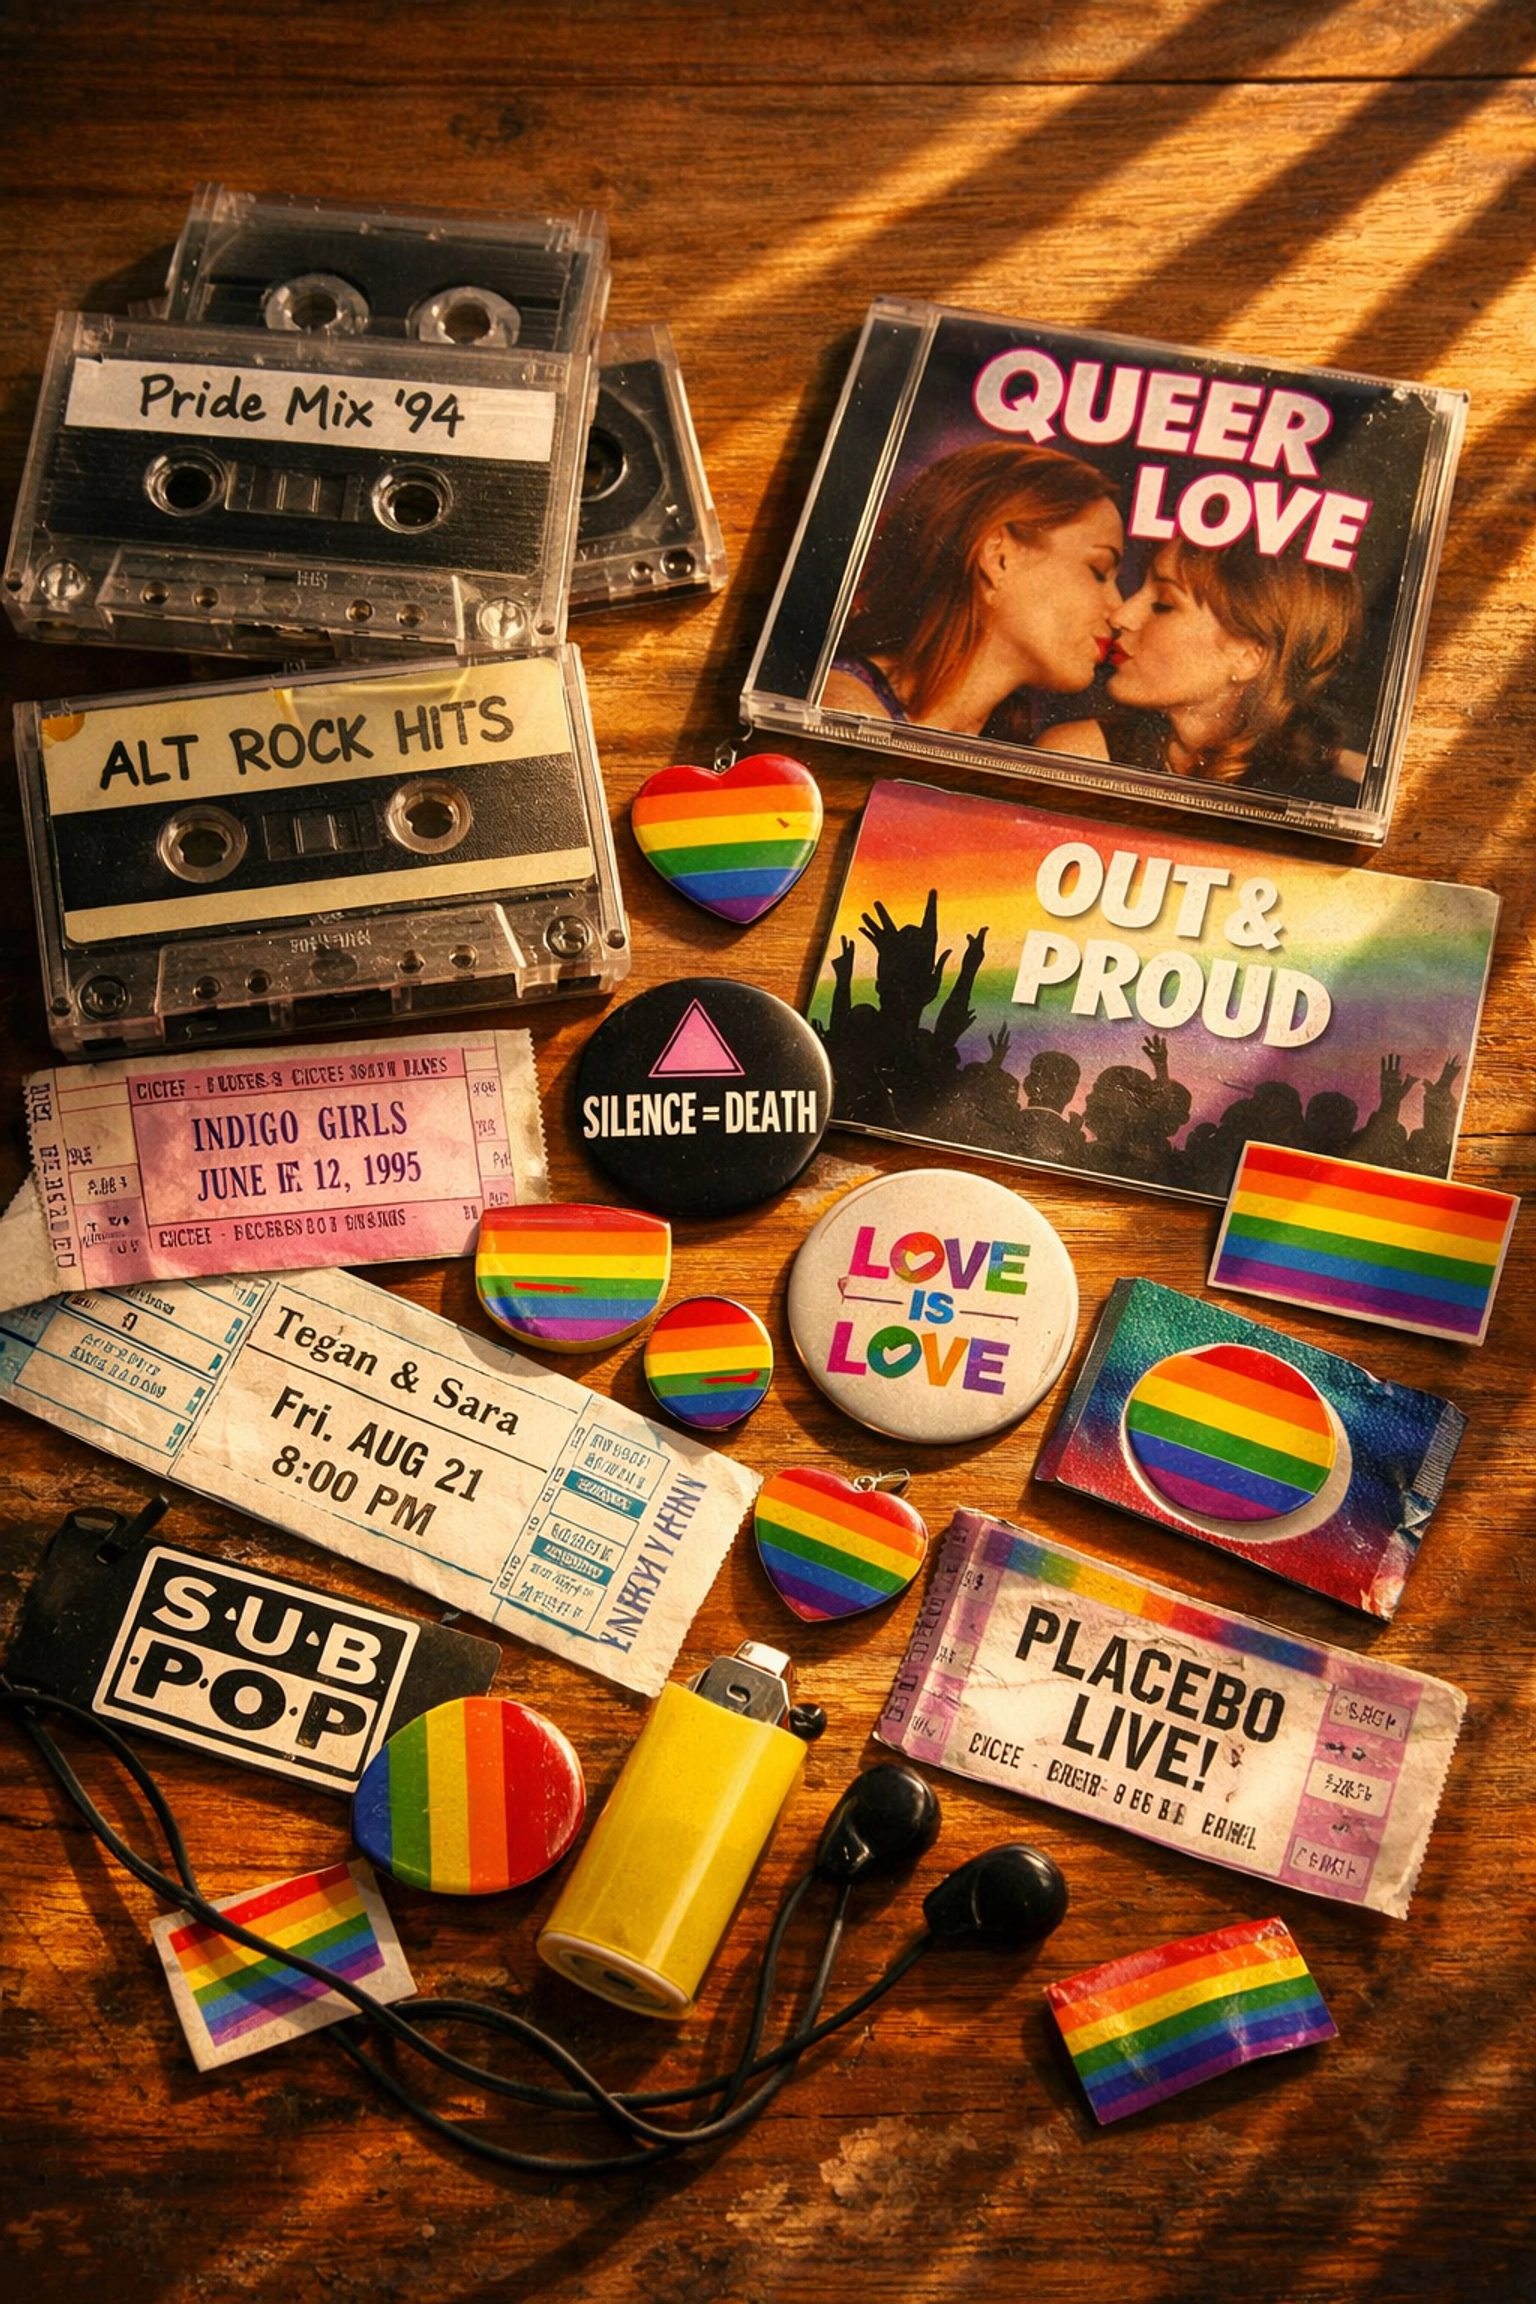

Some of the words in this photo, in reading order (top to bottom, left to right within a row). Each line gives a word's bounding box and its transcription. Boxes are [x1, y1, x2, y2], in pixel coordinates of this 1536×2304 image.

[139, 373, 267, 422] Pride
[285, 384, 373, 431] Mix
[395, 387, 466, 438] '94
[972, 346, 1334, 478] QUEER
[1128, 464, 1373, 571] LOVE
[99, 734, 199, 790] ALT
[228, 713, 374, 775] ROCK
[394, 695, 514, 755] HITS
[1010, 929, 1332, 1049] PROUD
[191, 1109, 299, 1152] INDIGO
[317, 1100, 408, 1141] GIRLS
[197, 1164, 267, 1202] JUNE
[313, 1157, 351, 1193] 12,
[363, 1150, 422, 1186] 1995
[848, 1225, 1031, 1296] LOVE
[908, 1289, 955, 1325] IS
[273, 1305, 379, 1377] Tegan
[389, 1360, 420, 1394] &
[432, 1376, 520, 1436] Sara
[826, 1320, 1011, 1396] LOVE
[269, 1385, 333, 1442] Fri.
[346, 1421, 430, 1479] AUG
[434, 1457, 484, 1503] 21
[271, 1444, 359, 1503] 8:00
[363, 1483, 438, 1537] PM
[1014, 1604, 1286, 1743] PLACEBO
[1061, 1692, 1220, 1793] LIVE!
